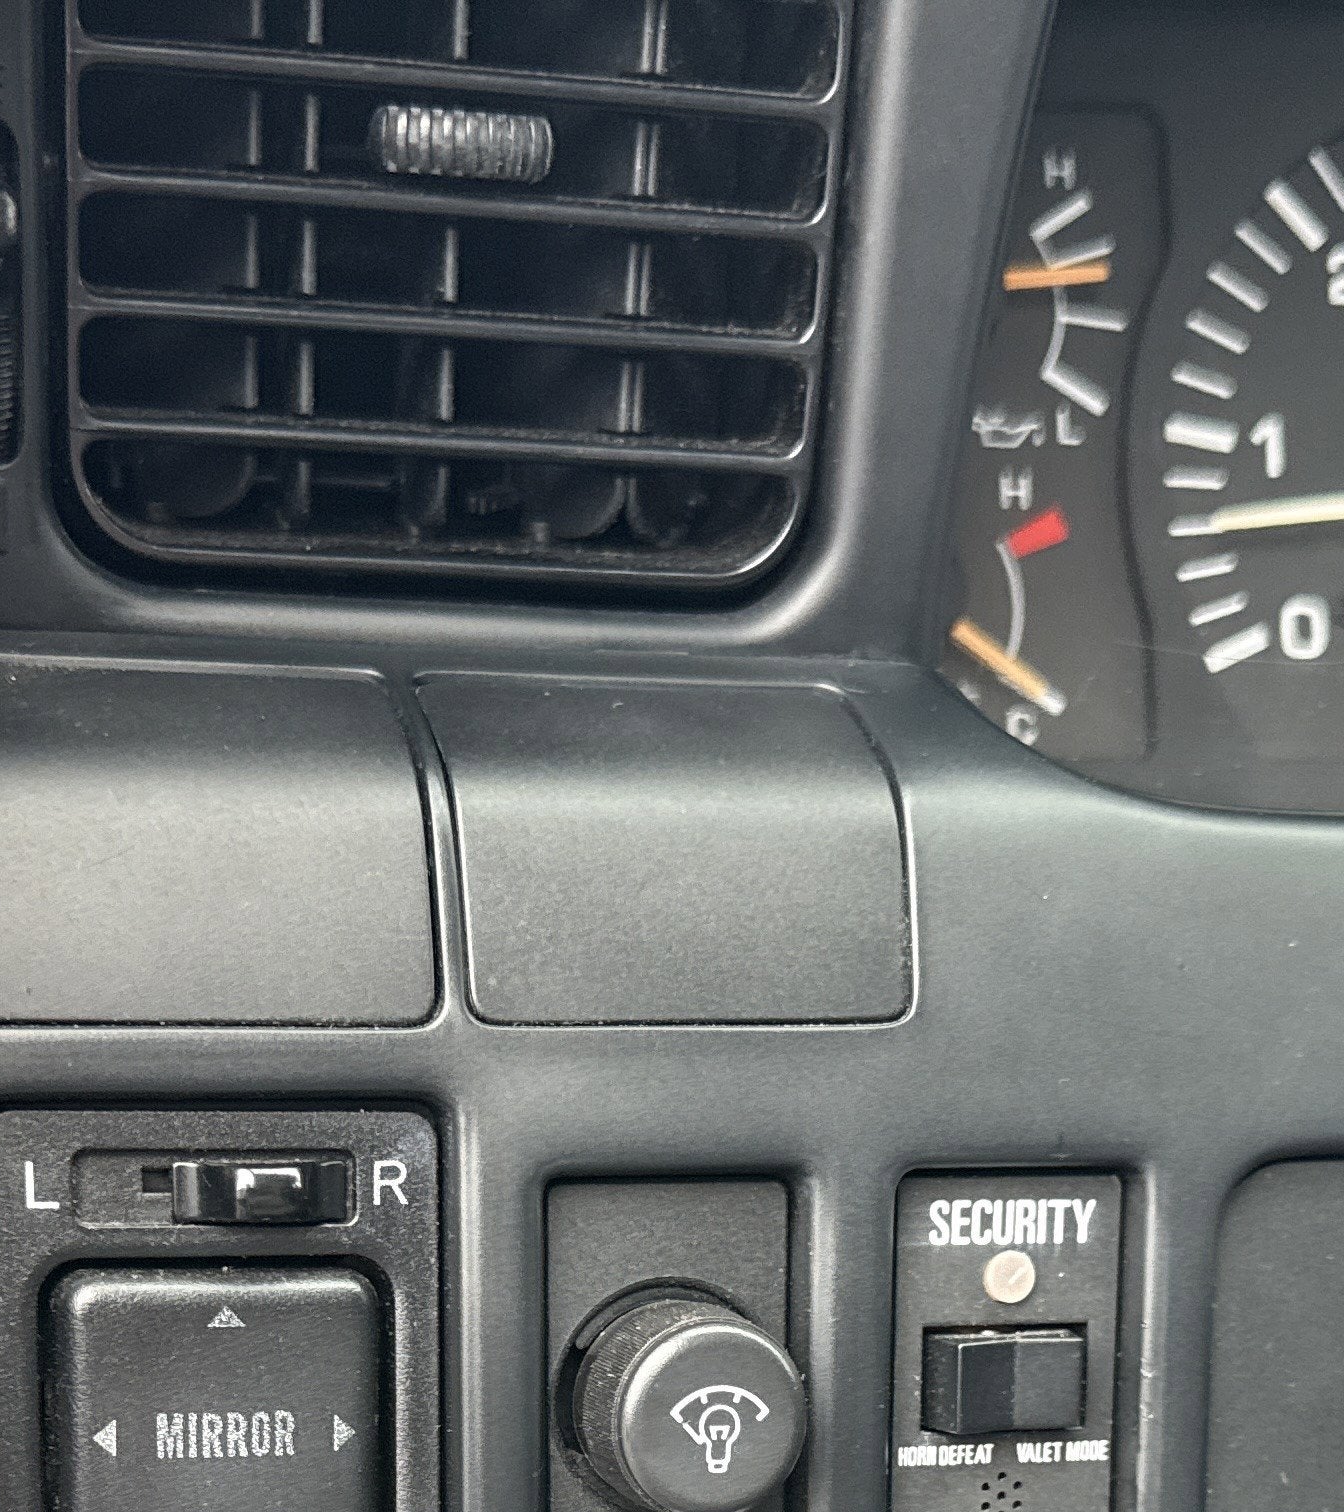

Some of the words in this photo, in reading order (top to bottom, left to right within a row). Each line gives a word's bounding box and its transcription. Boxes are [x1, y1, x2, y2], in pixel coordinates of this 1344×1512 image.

[1042, 152, 1077, 190] H
[1056, 403, 1085, 446] L
[1250, 413, 1286, 478] 1
[998, 466, 1033, 510] H
[1280, 594, 1329, 659] 0
[25, 1161, 60, 1209] L
[373, 1160, 408, 1206] R
[928, 1199, 1096, 1246] SECURITY
[156, 1409, 295, 1459] MIRROR
[898, 1446, 937, 1466] HORN
[938, 1443, 994, 1466] DEFEAT
[1016, 1442, 1063, 1463] VALET
[1065, 1439, 1110, 1461] MODE
